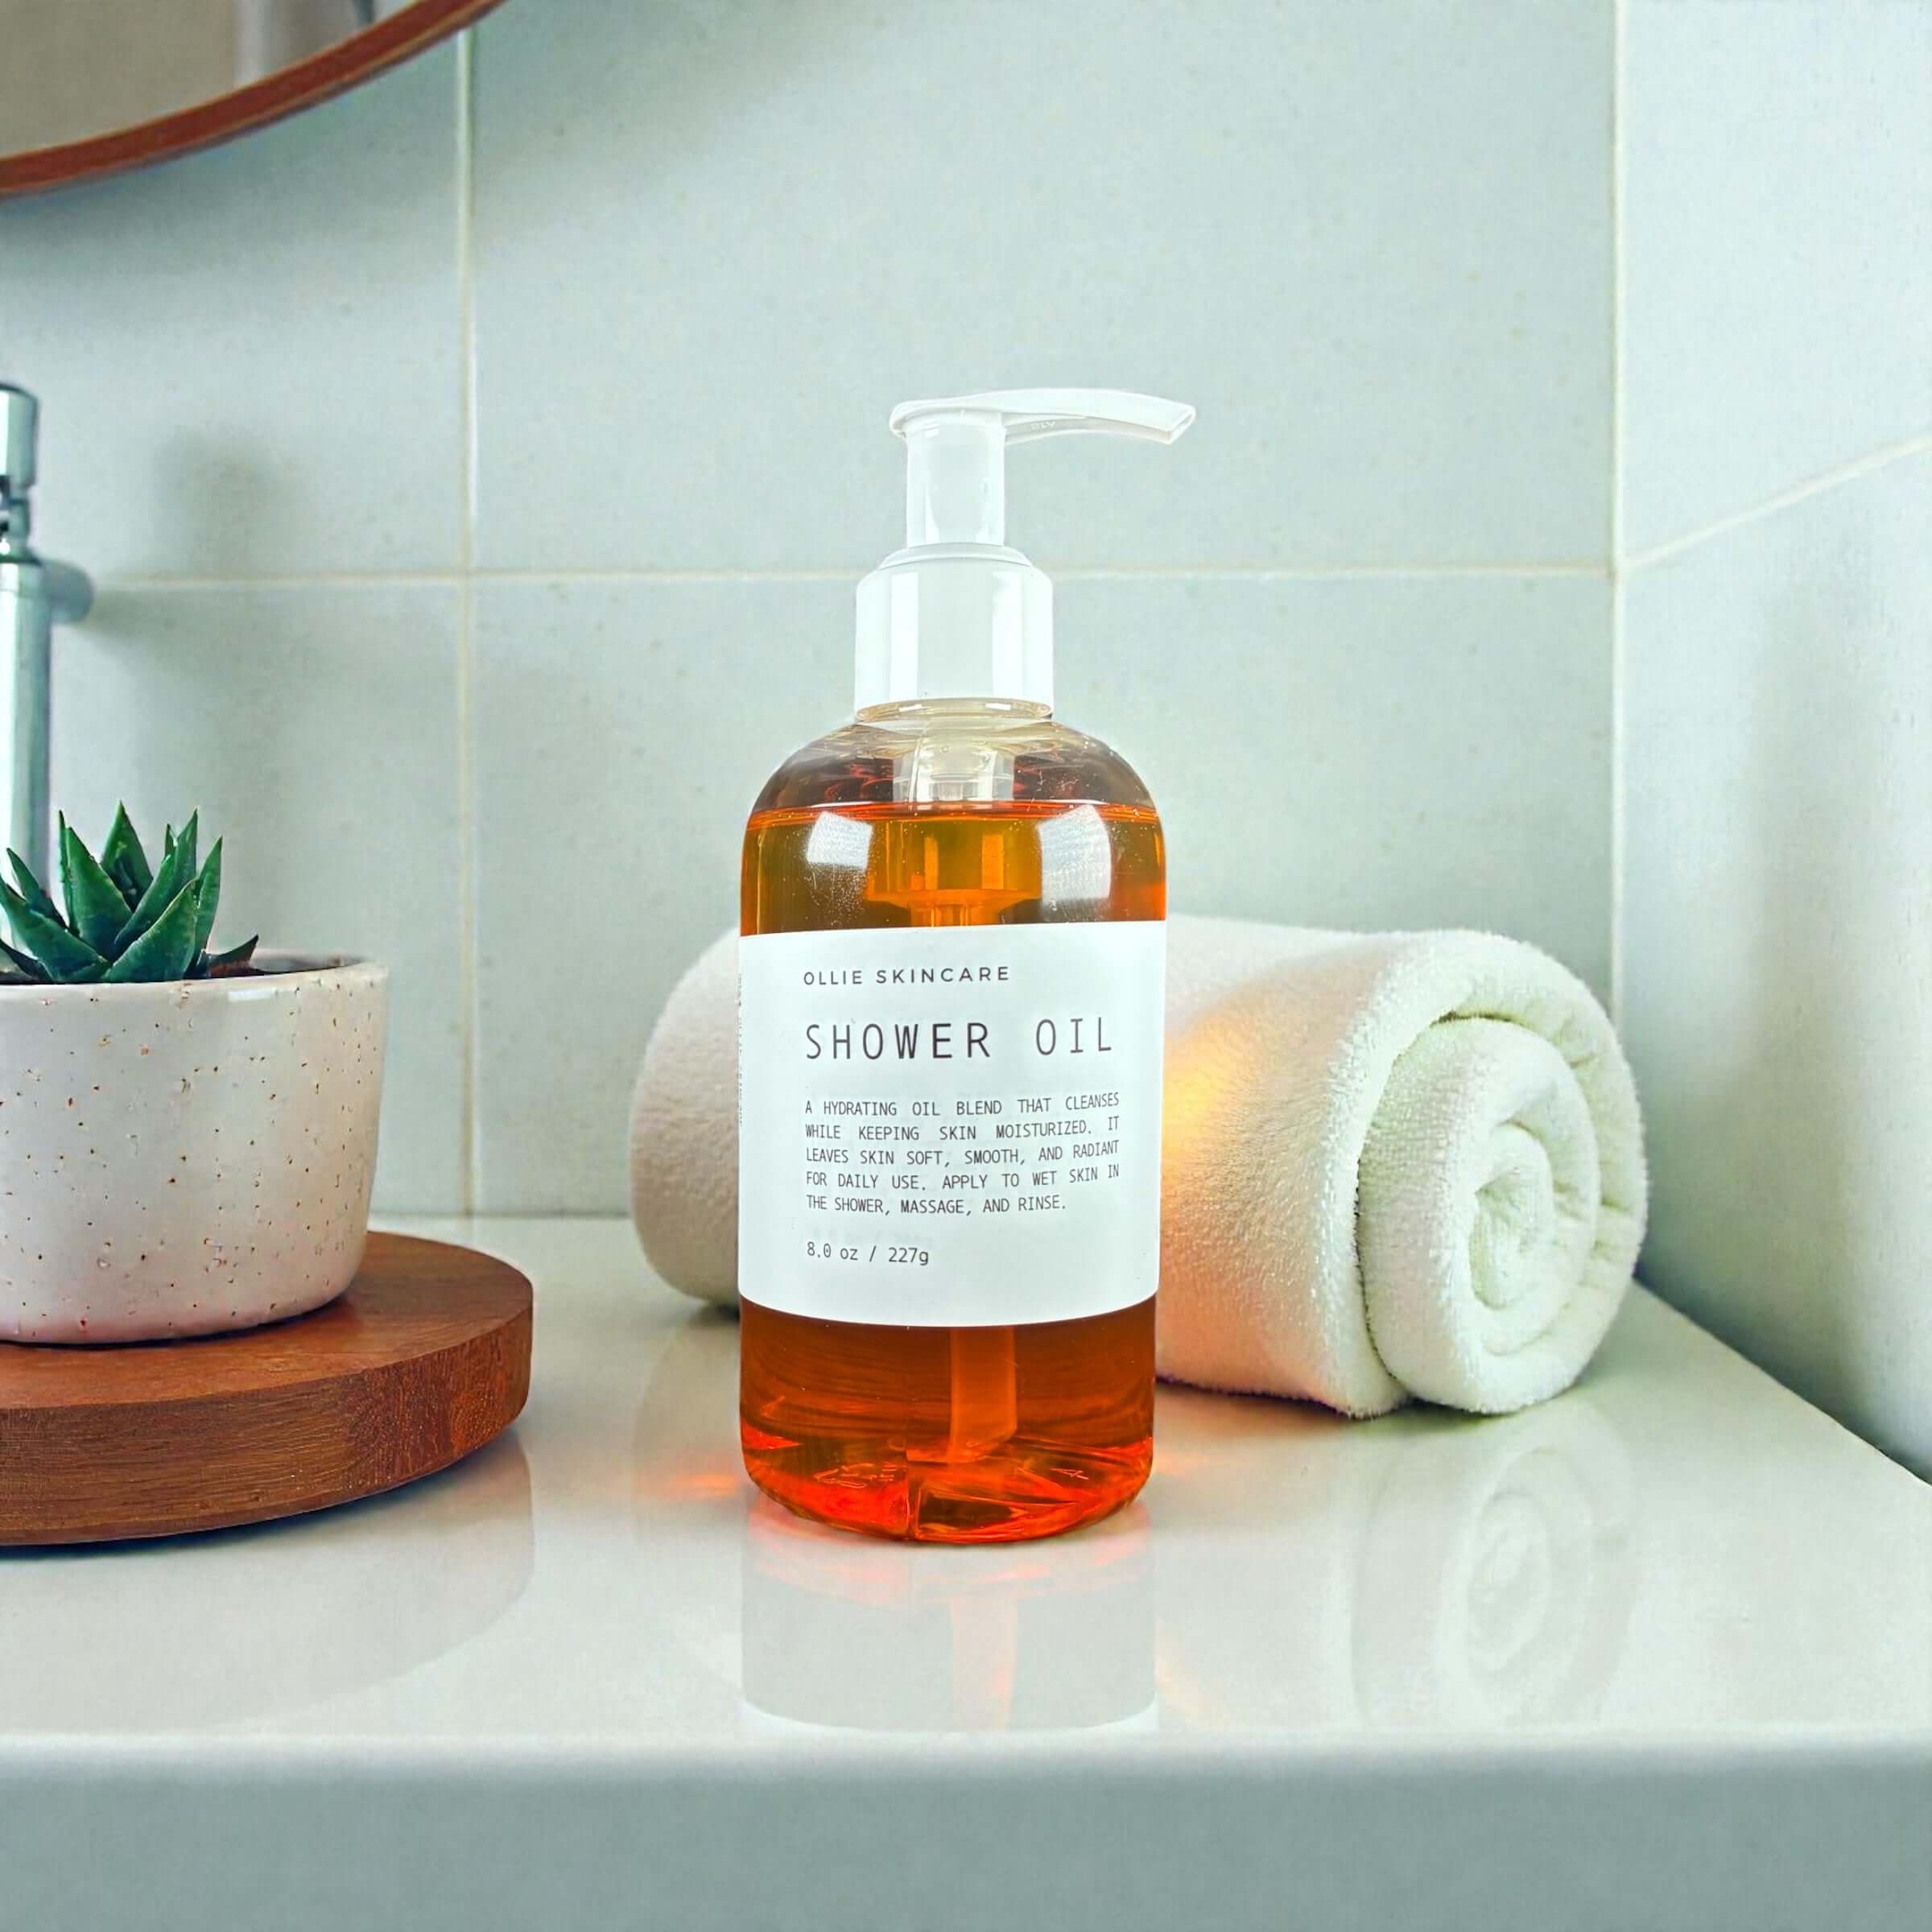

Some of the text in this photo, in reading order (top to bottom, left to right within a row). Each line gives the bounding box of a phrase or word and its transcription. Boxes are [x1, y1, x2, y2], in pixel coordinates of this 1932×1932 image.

[803, 966, 1009, 986] OLLIE SKINCARE
[806, 1017, 1113, 1060] SHOWER OIL
[805, 1092, 1120, 1117] A HYDRATING OIL BLEND THAT CLEANSES
[805, 1115, 1120, 1141] WHILE KEEPING SKIN MOISTURIZED. IT
[806, 1139, 1120, 1168] LEAVES SKIN SOFT, SMOOTH, AND RADIANT
[806, 1163, 1120, 1191] FOR DAILY USE. APPLY TO WET SKIN IN
[806, 1194, 1066, 1216] THE SHOWER, MASSAGE, AND RINSE.
[807, 1241, 929, 1266] 8.0 oz / 227g
